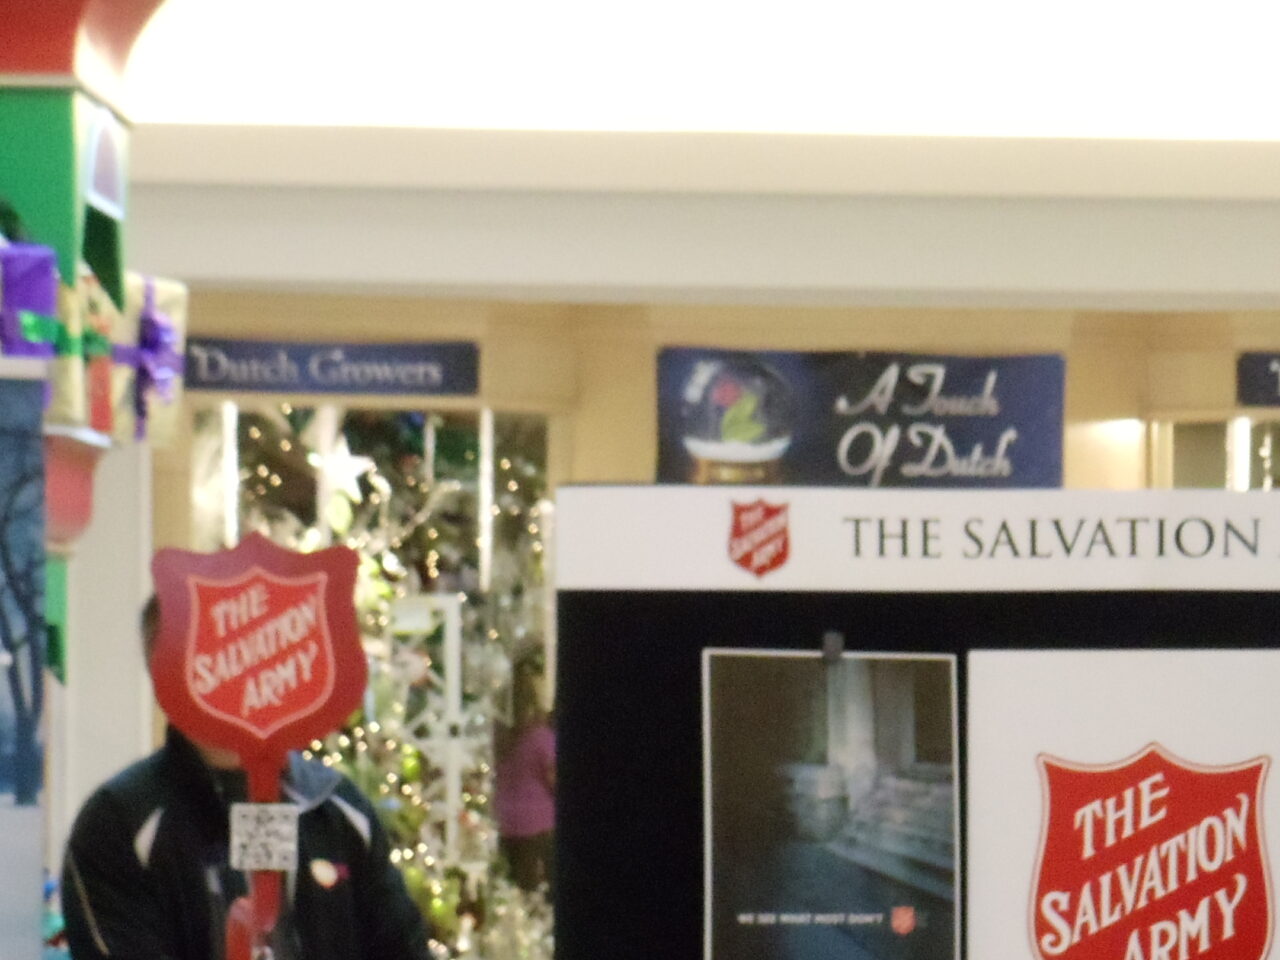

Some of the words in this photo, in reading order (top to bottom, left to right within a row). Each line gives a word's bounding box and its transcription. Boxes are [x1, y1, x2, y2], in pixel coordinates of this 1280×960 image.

[190, 345, 298, 383] Dutch
[308, 348, 443, 386] Growers
[835, 362, 900, 416] A
[902, 363, 1000, 416] Touch
[837, 421, 901, 487] Of
[901, 421, 1018, 477] Dutch
[843, 517, 943, 558] THE
[962, 516, 1262, 559] SALVATION
[210, 582, 270, 638] THE
[190, 594, 318, 694] SALVATION
[240, 640, 320, 717] ARMY
[1073, 772, 1170, 860] THE
[1041, 793, 1250, 956] SALVATION
